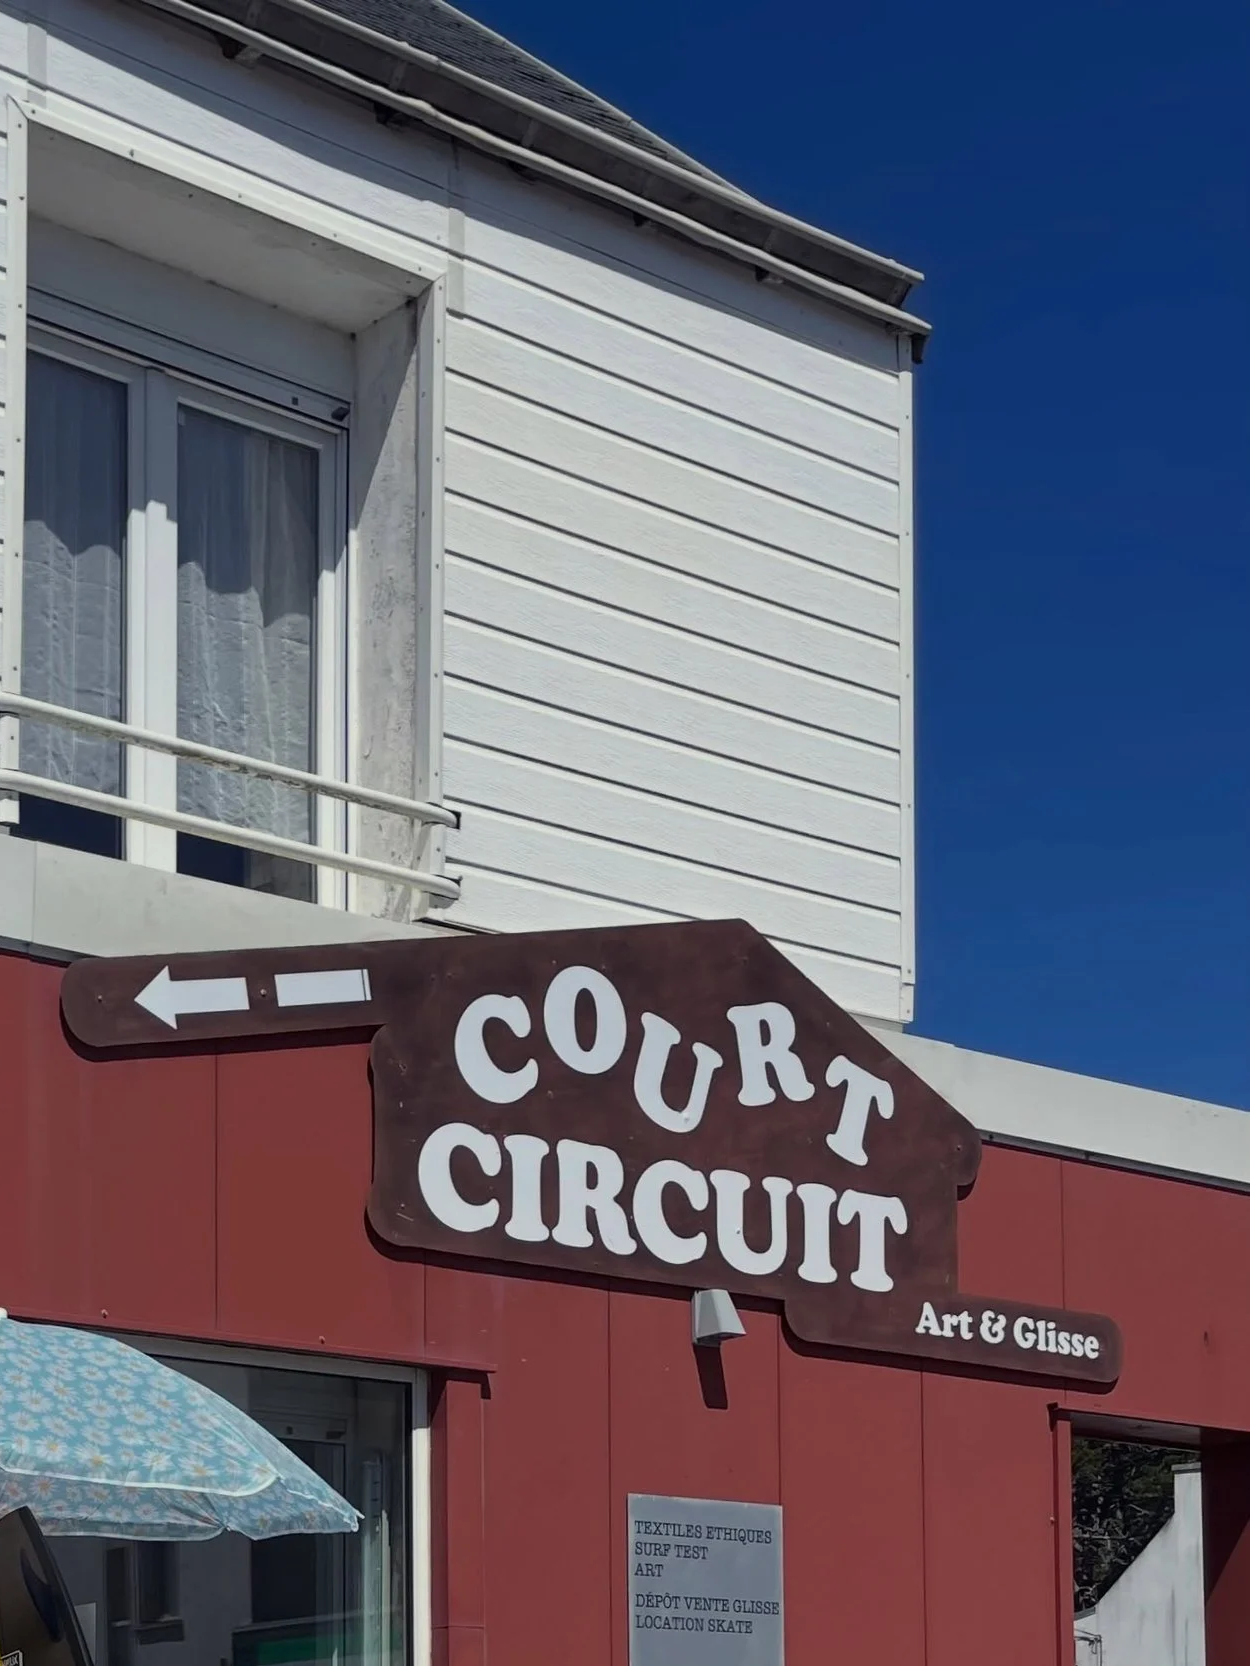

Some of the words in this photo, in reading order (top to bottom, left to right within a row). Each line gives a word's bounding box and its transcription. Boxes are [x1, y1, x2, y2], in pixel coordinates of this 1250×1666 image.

[454, 965, 895, 1167] COURT
[417, 1122, 908, 1292] CIRCUIT
[914, 1301, 972, 1340] Art
[980, 1310, 1006, 1343] &
[1011, 1315, 1100, 1361] Glisse
[634, 1520, 703, 1540] TEXTILES
[706, 1526, 773, 1545] ETHIQUES
[634, 1543, 672, 1558] SURF
[674, 1544, 709, 1561] TEST
[634, 1562, 664, 1578] ART
[635, 1591, 681, 1611] DÉPÔT
[684, 1596, 730, 1613] VENTE
[732, 1598, 780, 1616] GLISSE
[635, 1615, 705, 1633] LOCATION
[707, 1618, 753, 1634] SKATE
